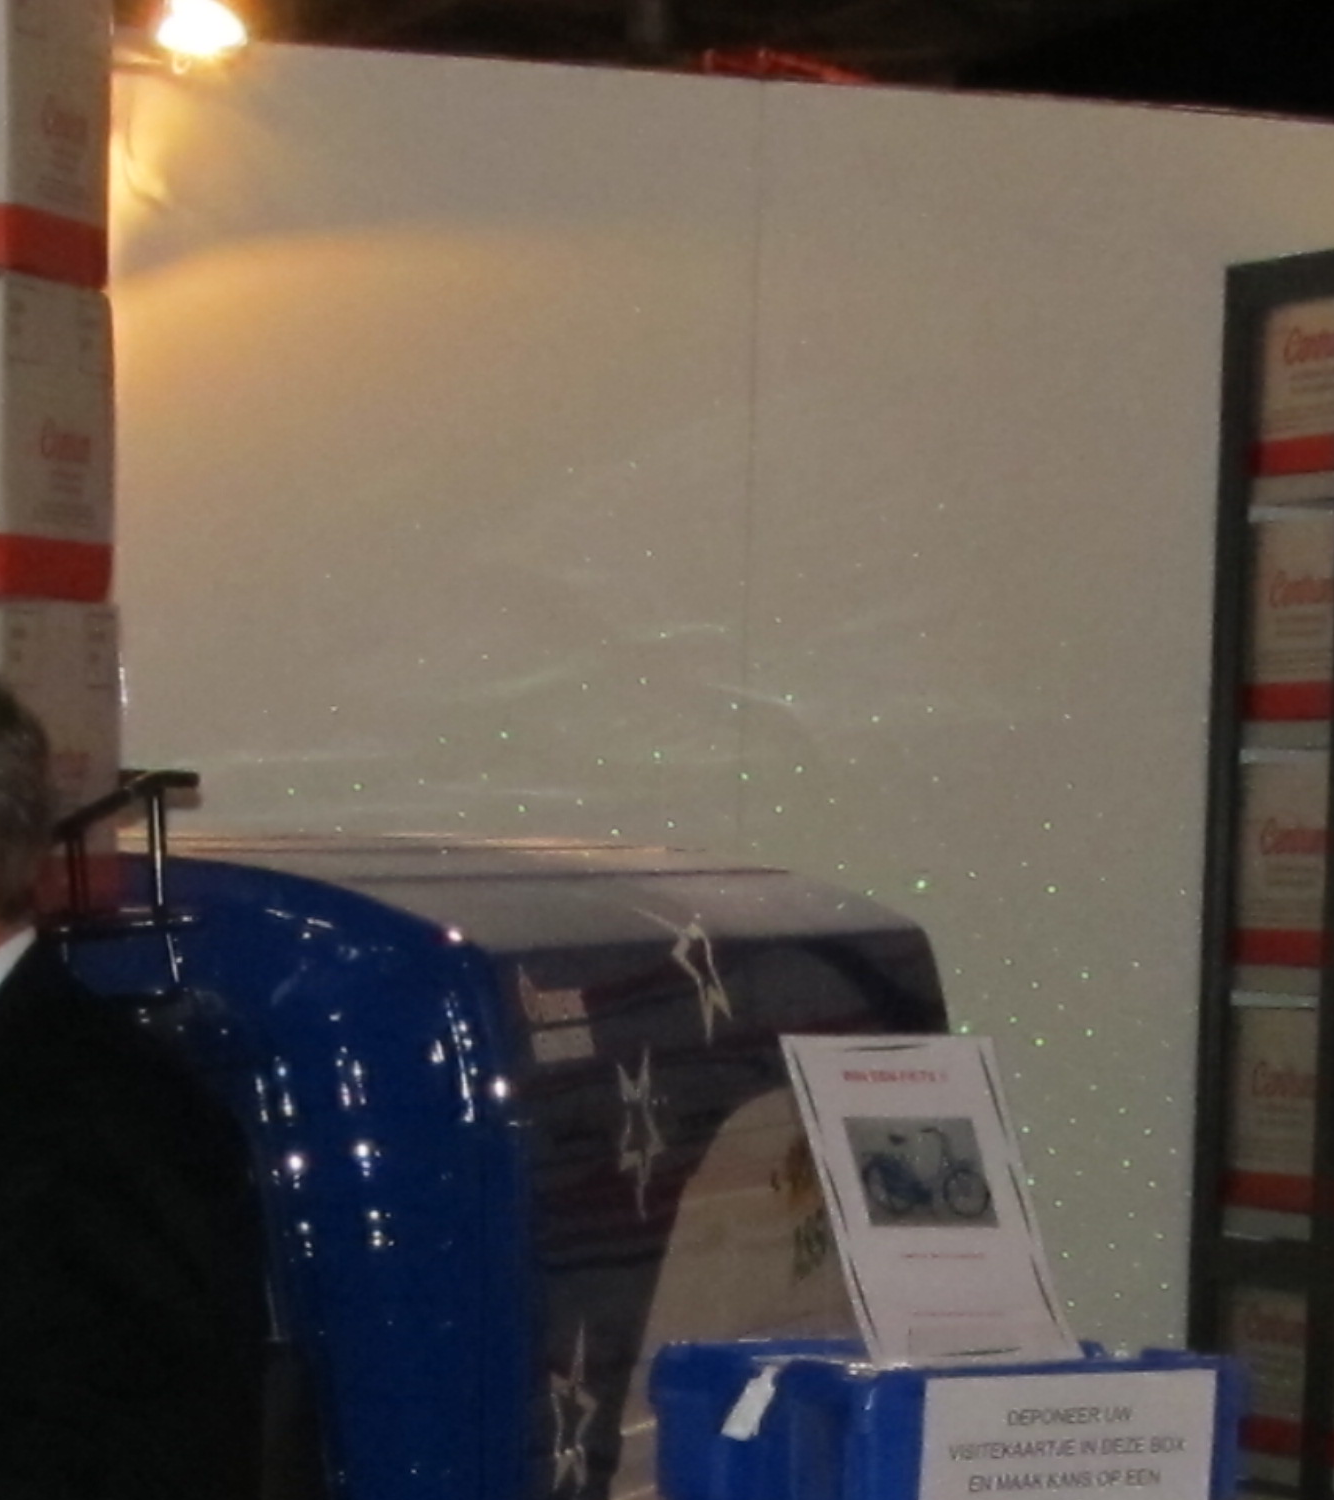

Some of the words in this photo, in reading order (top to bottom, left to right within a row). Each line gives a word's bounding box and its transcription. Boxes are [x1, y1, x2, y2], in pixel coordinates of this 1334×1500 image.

[1007, 1407, 1101, 1427] DEPONEER
[1105, 1406, 1133, 1423] UW
[949, 1439, 1076, 1461] VISITEKAARTJE
[1080, 1438, 1097, 1456] IN
[1101, 1437, 1144, 1456] DEZE
[1150, 1436, 1187, 1453] BOX
[969, 1475, 992, 1492] EN
[996, 1472, 1043, 1491] MAAK
[1047, 1470, 1092, 1489] KANS
[1097, 1469, 1120, 1486] OP
[1125, 1468, 1162, 1487] EEN
